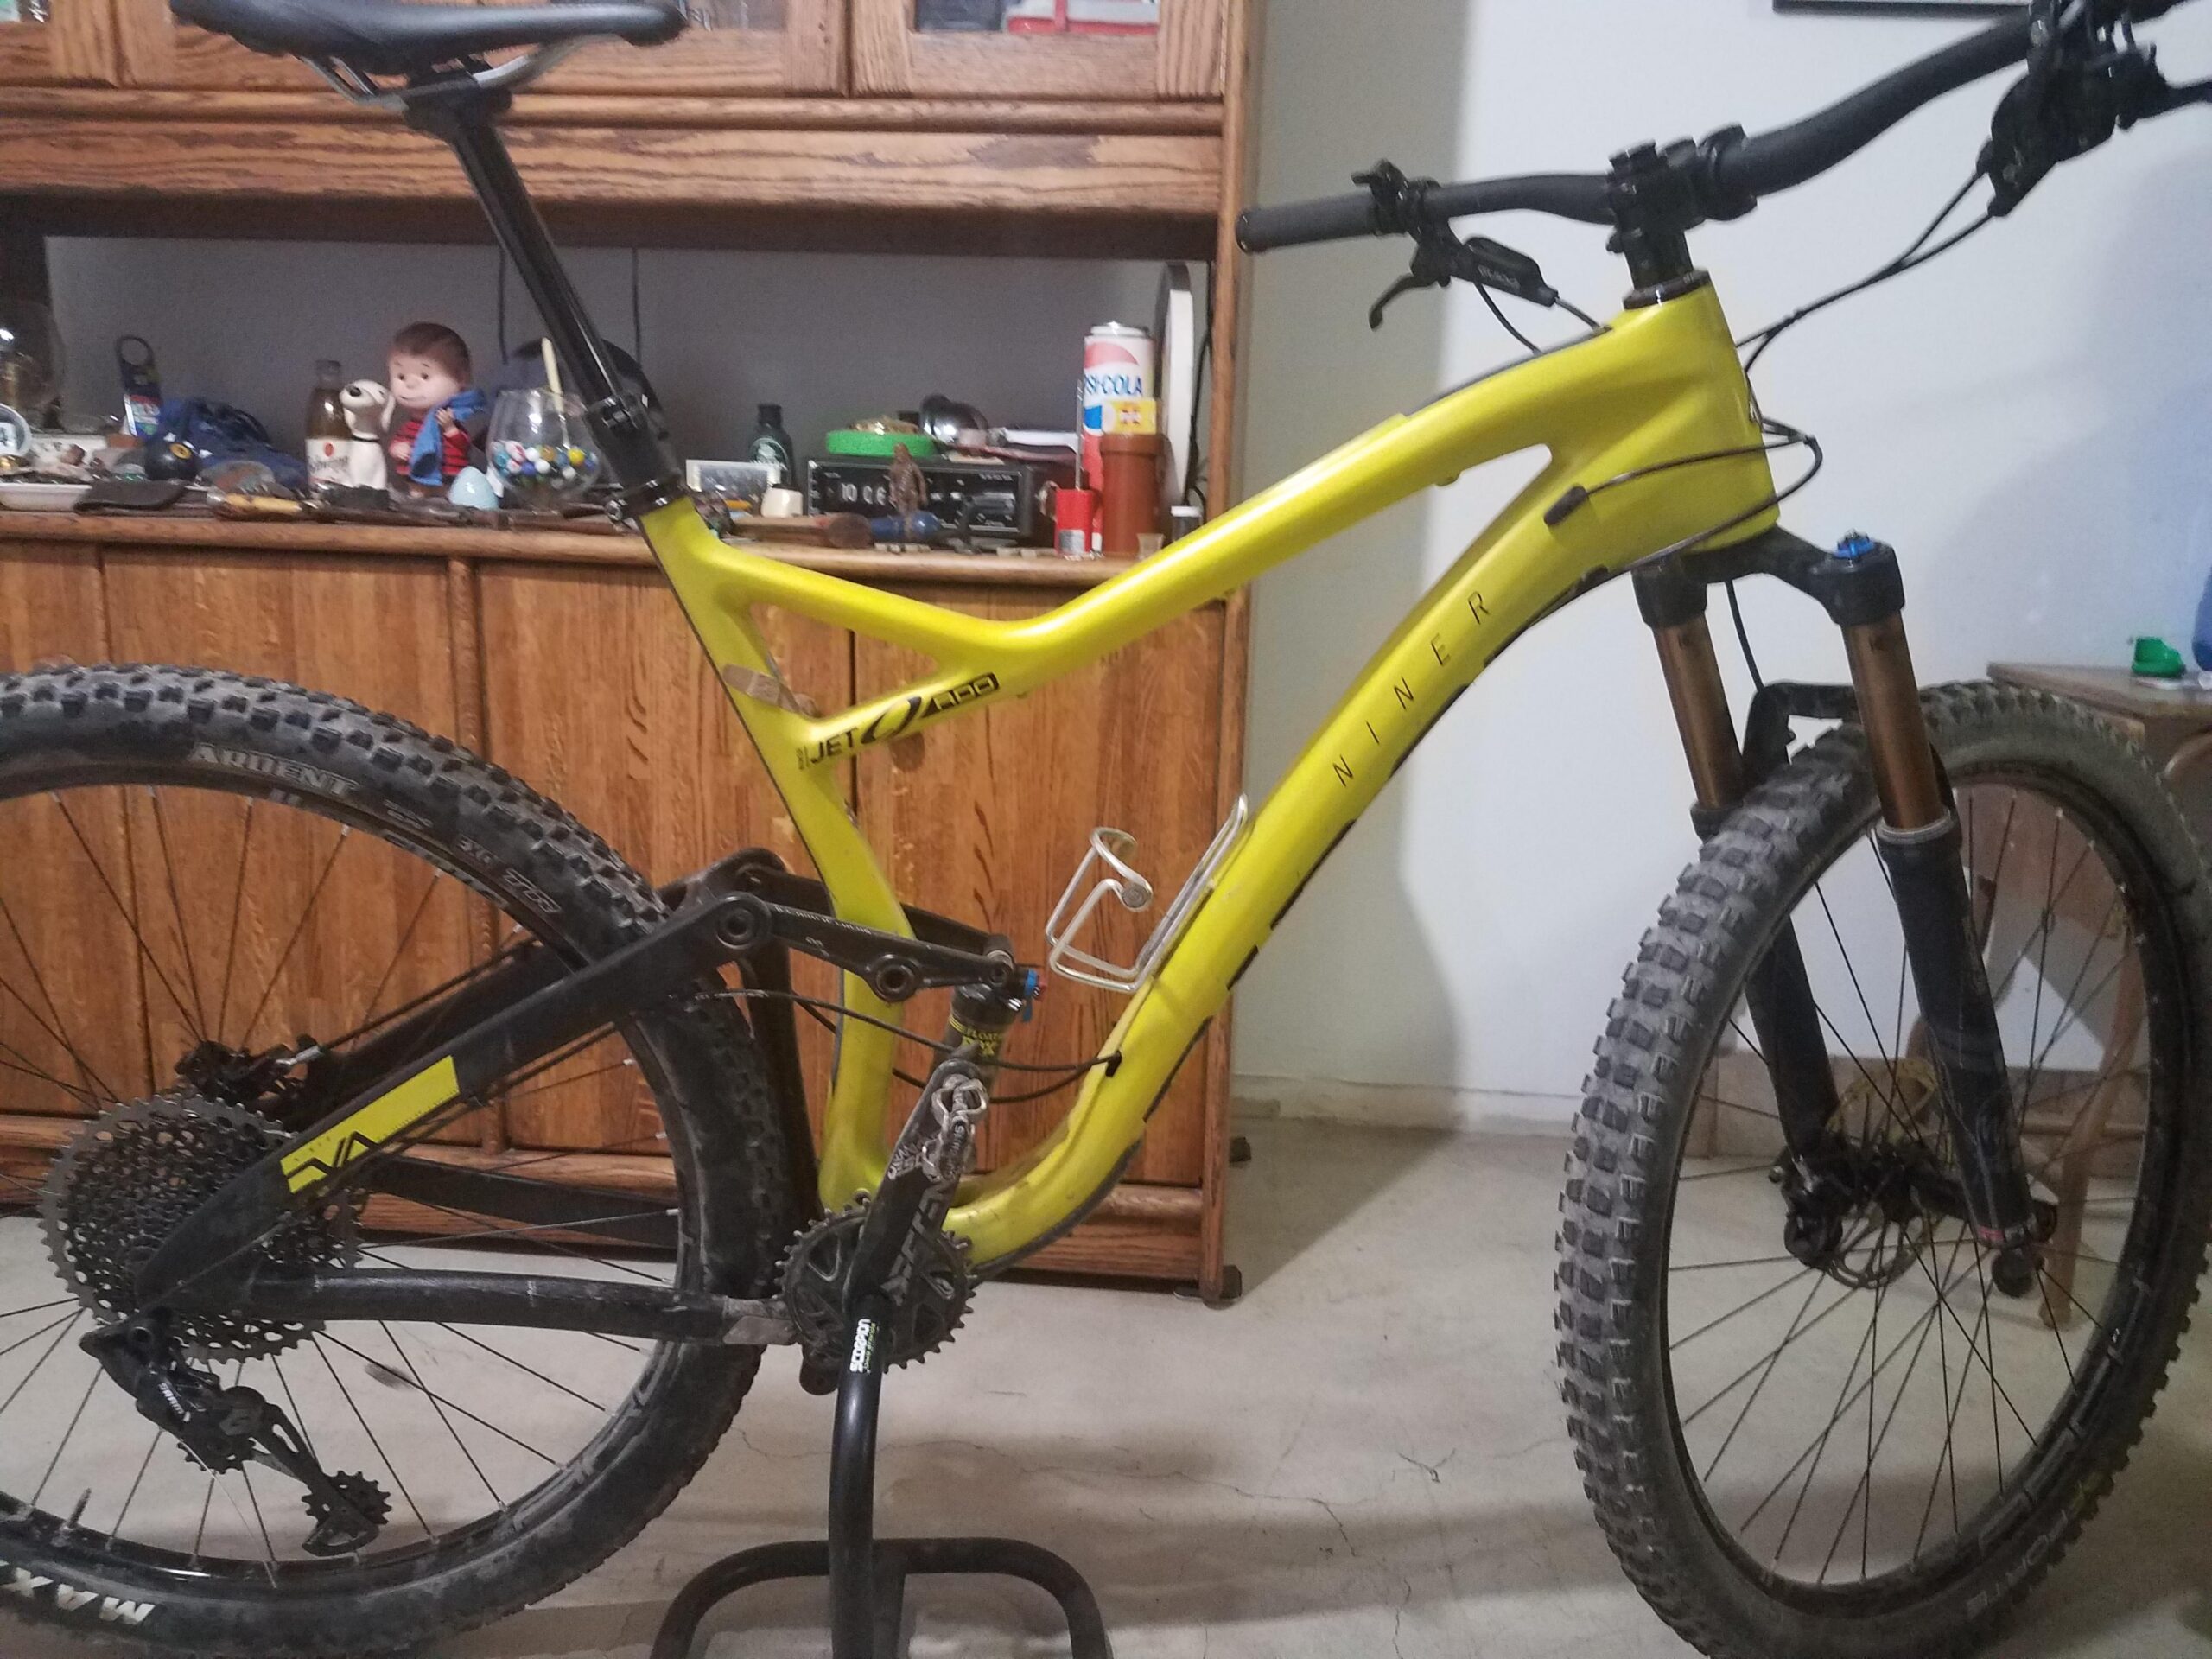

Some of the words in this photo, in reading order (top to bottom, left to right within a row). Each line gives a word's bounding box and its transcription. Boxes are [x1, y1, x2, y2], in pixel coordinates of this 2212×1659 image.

[1332, 591, 1491, 788] NINER
[187, 741, 360, 796] ARDENT
[810, 727, 859, 764] JET
[850, 1319, 871, 1373] SCORPION
[158, 1382, 185, 1414] SRAM
